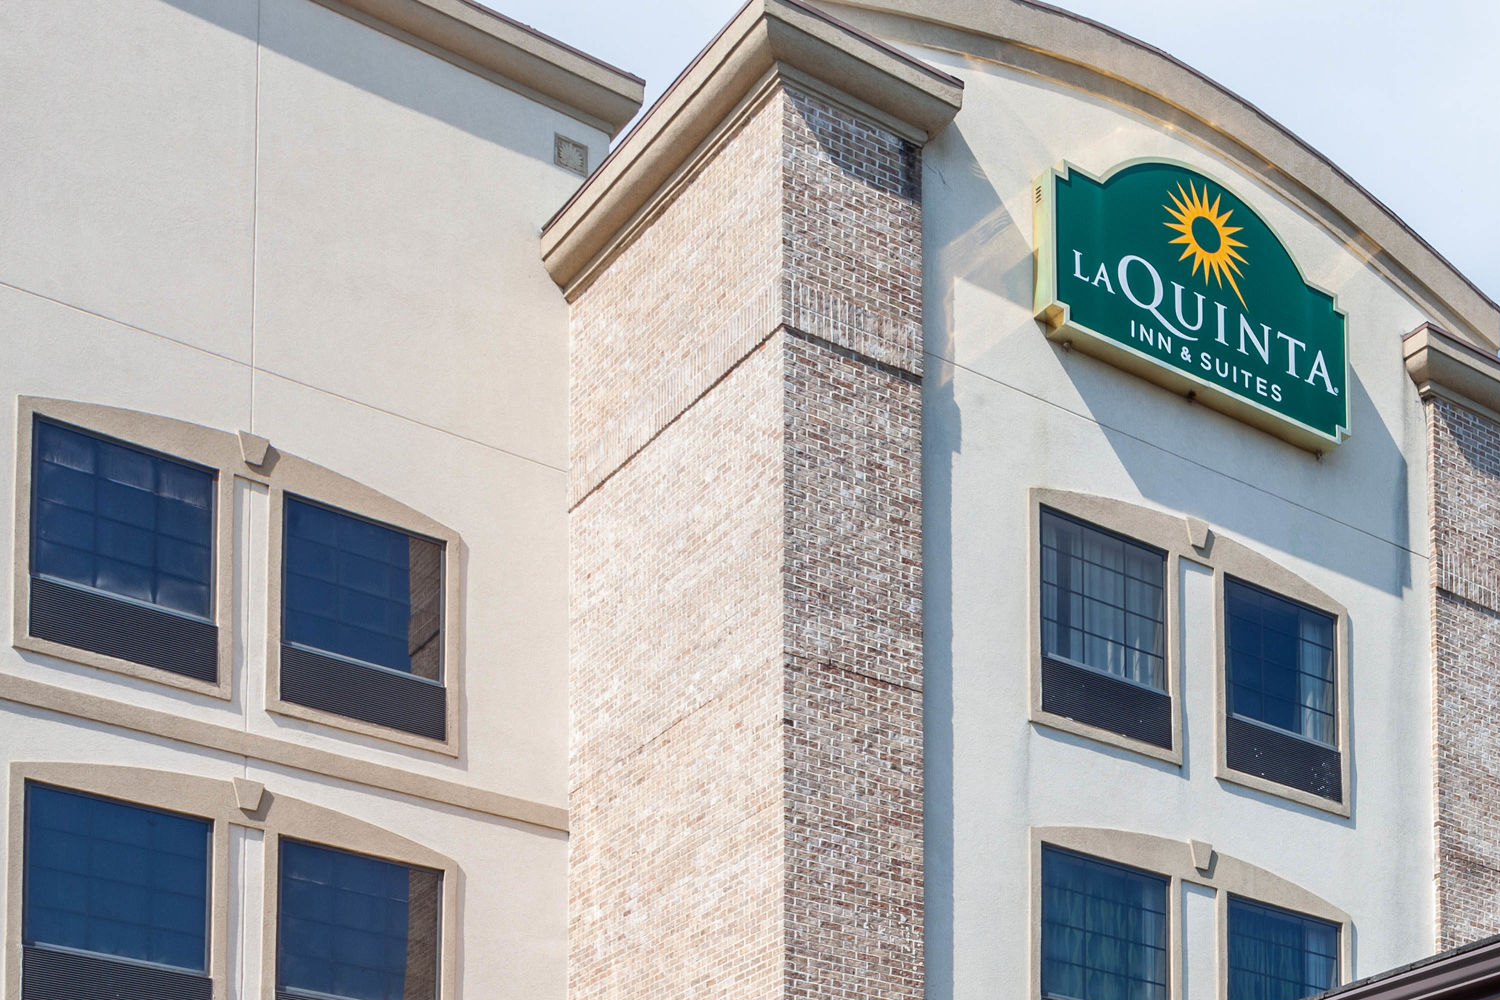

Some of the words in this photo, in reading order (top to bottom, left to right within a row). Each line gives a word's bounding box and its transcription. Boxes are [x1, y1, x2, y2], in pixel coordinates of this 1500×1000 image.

[1130, 319, 1173, 354] INN
[1180, 346, 1192, 364] &
[1200, 352, 1283, 402] SUITES
